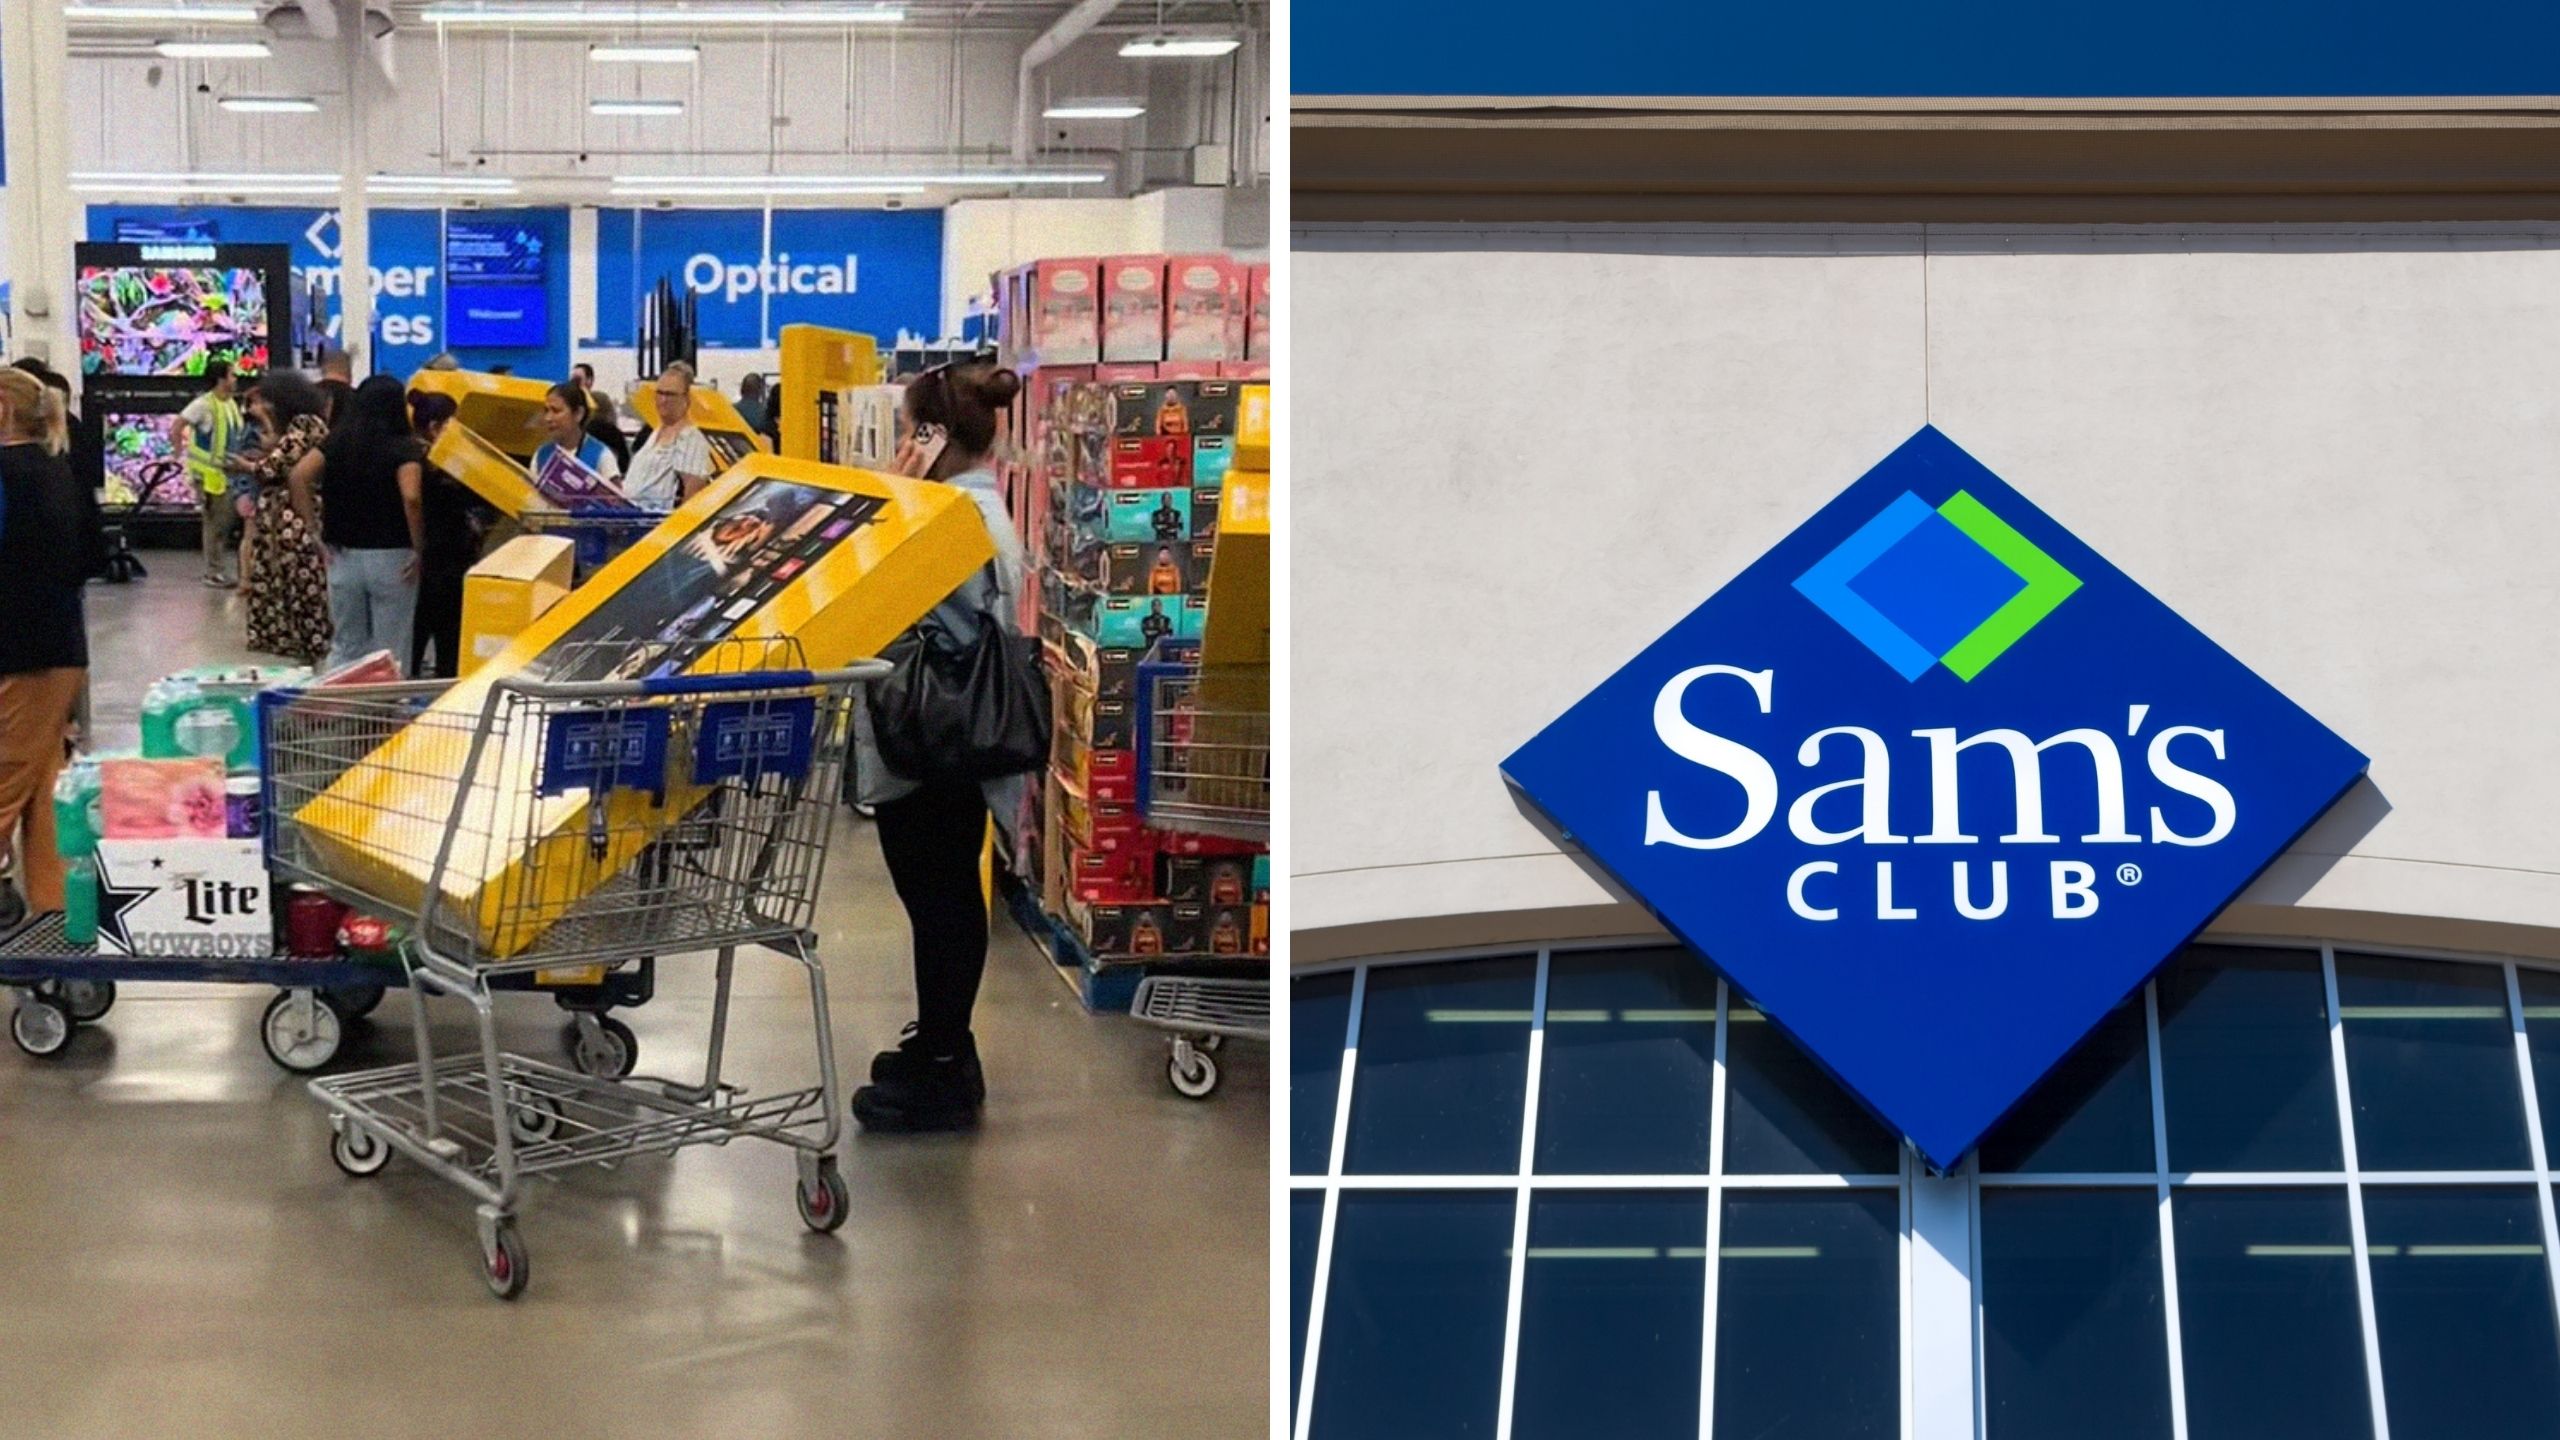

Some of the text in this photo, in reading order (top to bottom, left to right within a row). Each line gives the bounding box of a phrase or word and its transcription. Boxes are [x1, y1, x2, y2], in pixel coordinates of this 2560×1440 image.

[684, 252, 858, 303] Optical
[1644, 663, 2237, 850] Sam's
[184, 878, 260, 925] Lite
[131, 931, 273, 957] COWBOYS
